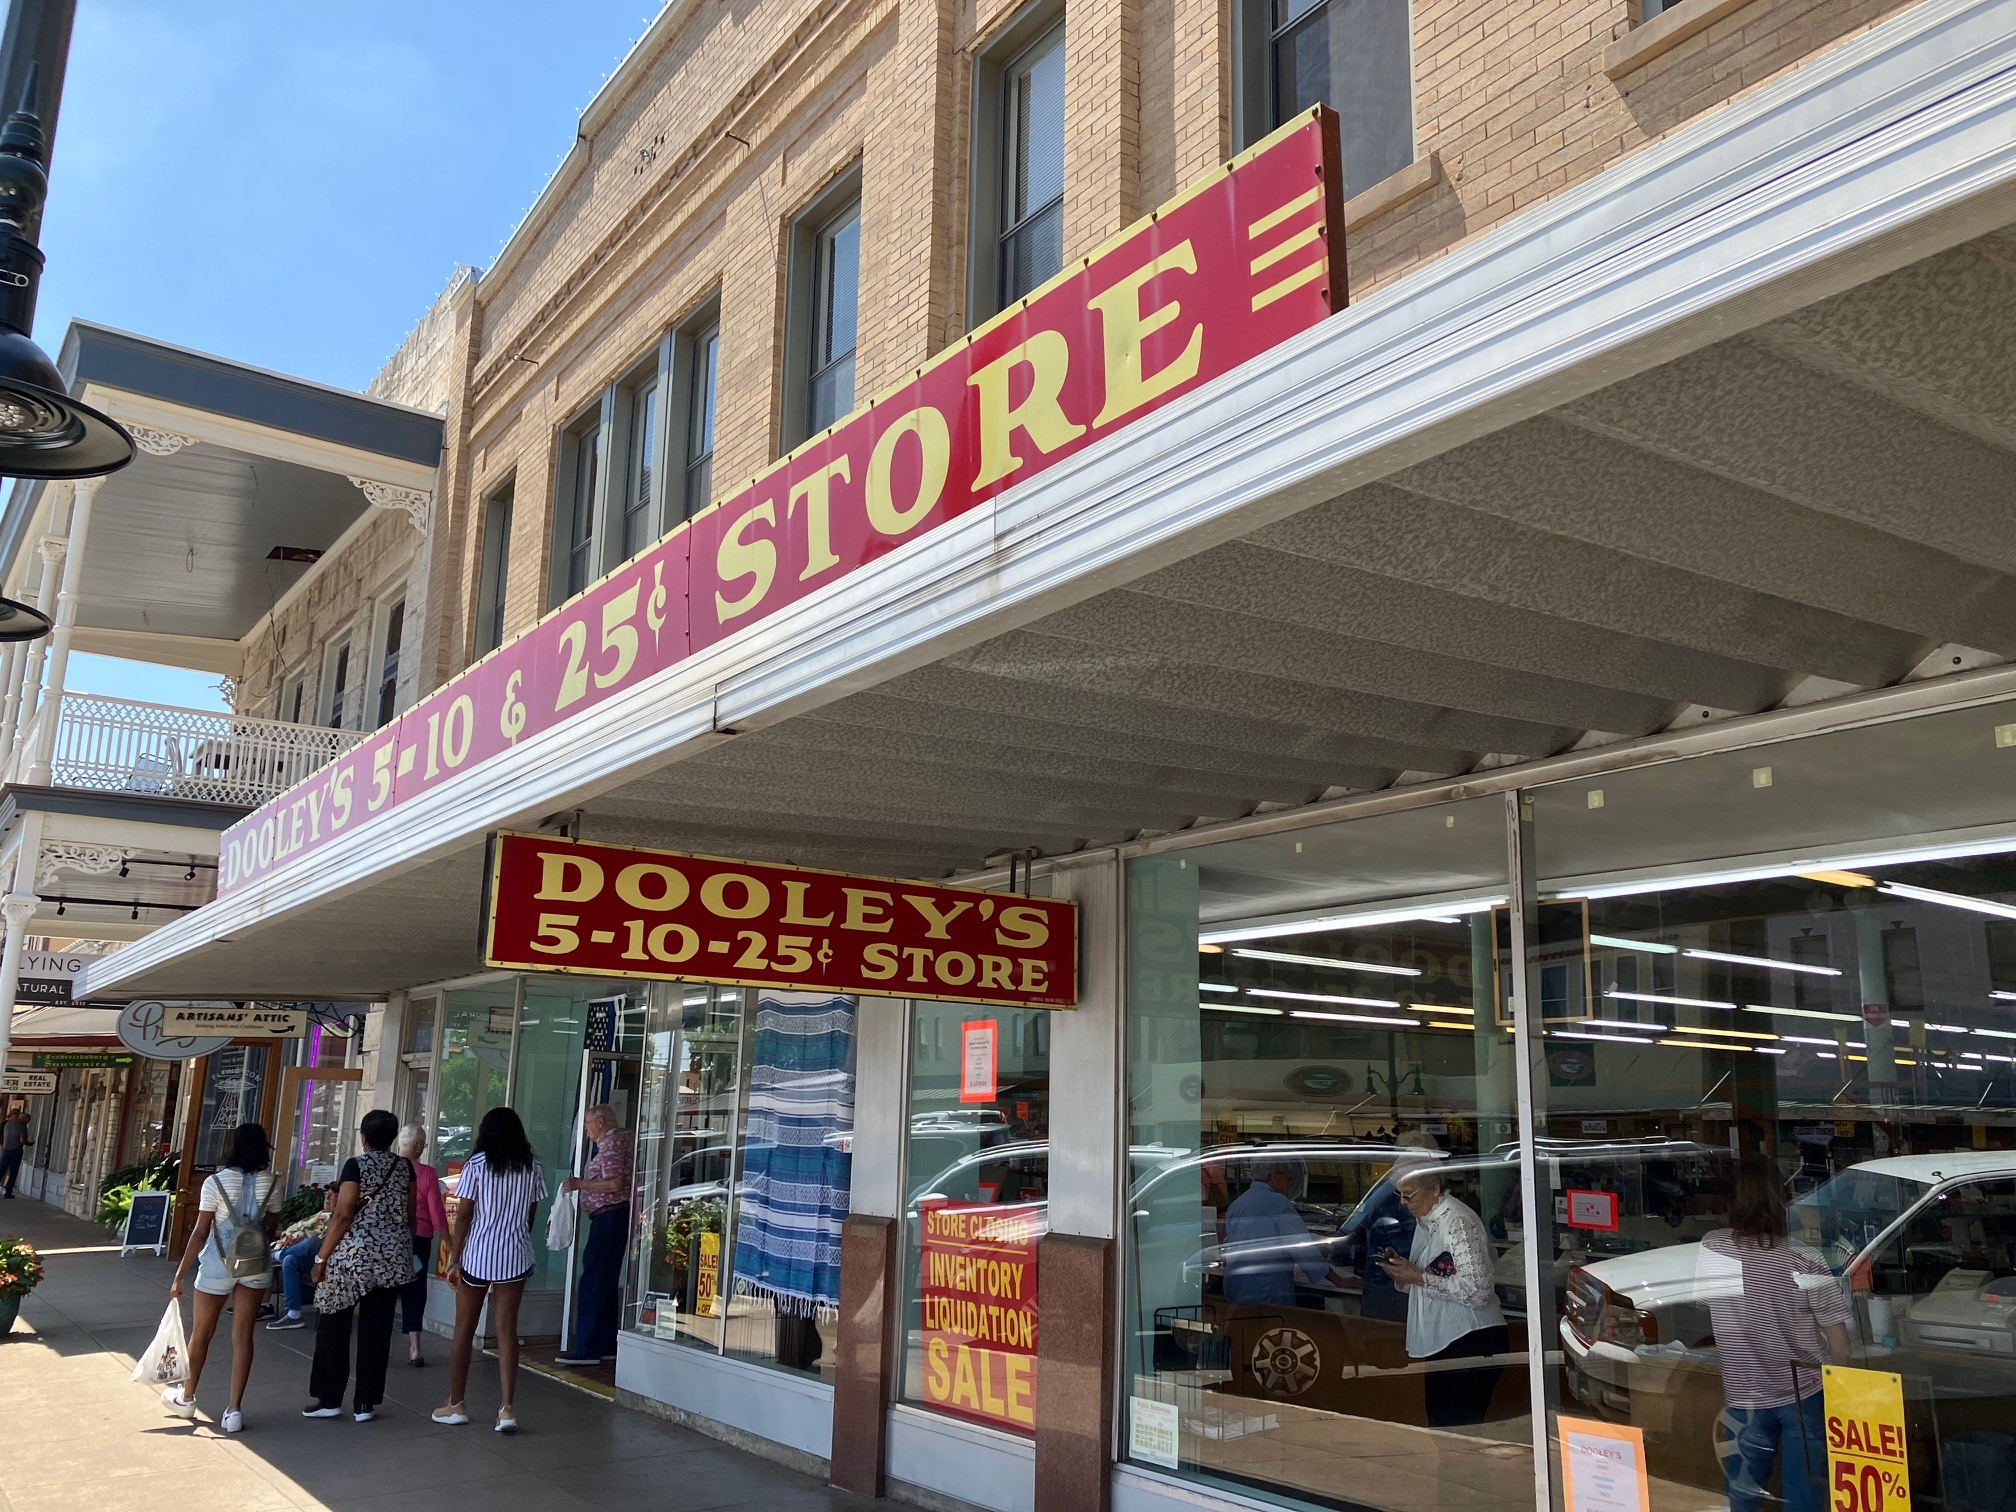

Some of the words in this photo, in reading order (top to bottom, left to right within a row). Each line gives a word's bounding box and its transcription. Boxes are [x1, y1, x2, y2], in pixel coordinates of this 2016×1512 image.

[226, 765, 354, 889] DOOLEY'S
[368, 695, 474, 811] 5-10
[500, 670, 527, 746] &
[715, 239, 1203, 624] STORE
[533, 852, 1050, 949] DOOLEY'S
[20, 956, 82, 973] YING
[860, 942, 1049, 993] STORE
[175, 1012, 248, 1021] ARTISANS'
[253, 1013, 291, 1023] ATTIC
[927, 1211, 966, 1238] STORE
[930, 1252, 1024, 1299] INVENTORY
[926, 1294, 1032, 1349] LIQUIDATION
[928, 1337, 1033, 1424] SALE
[1828, 1416, 1904, 1458] SALE!
[1835, 1461, 1906, 1512] 50%
